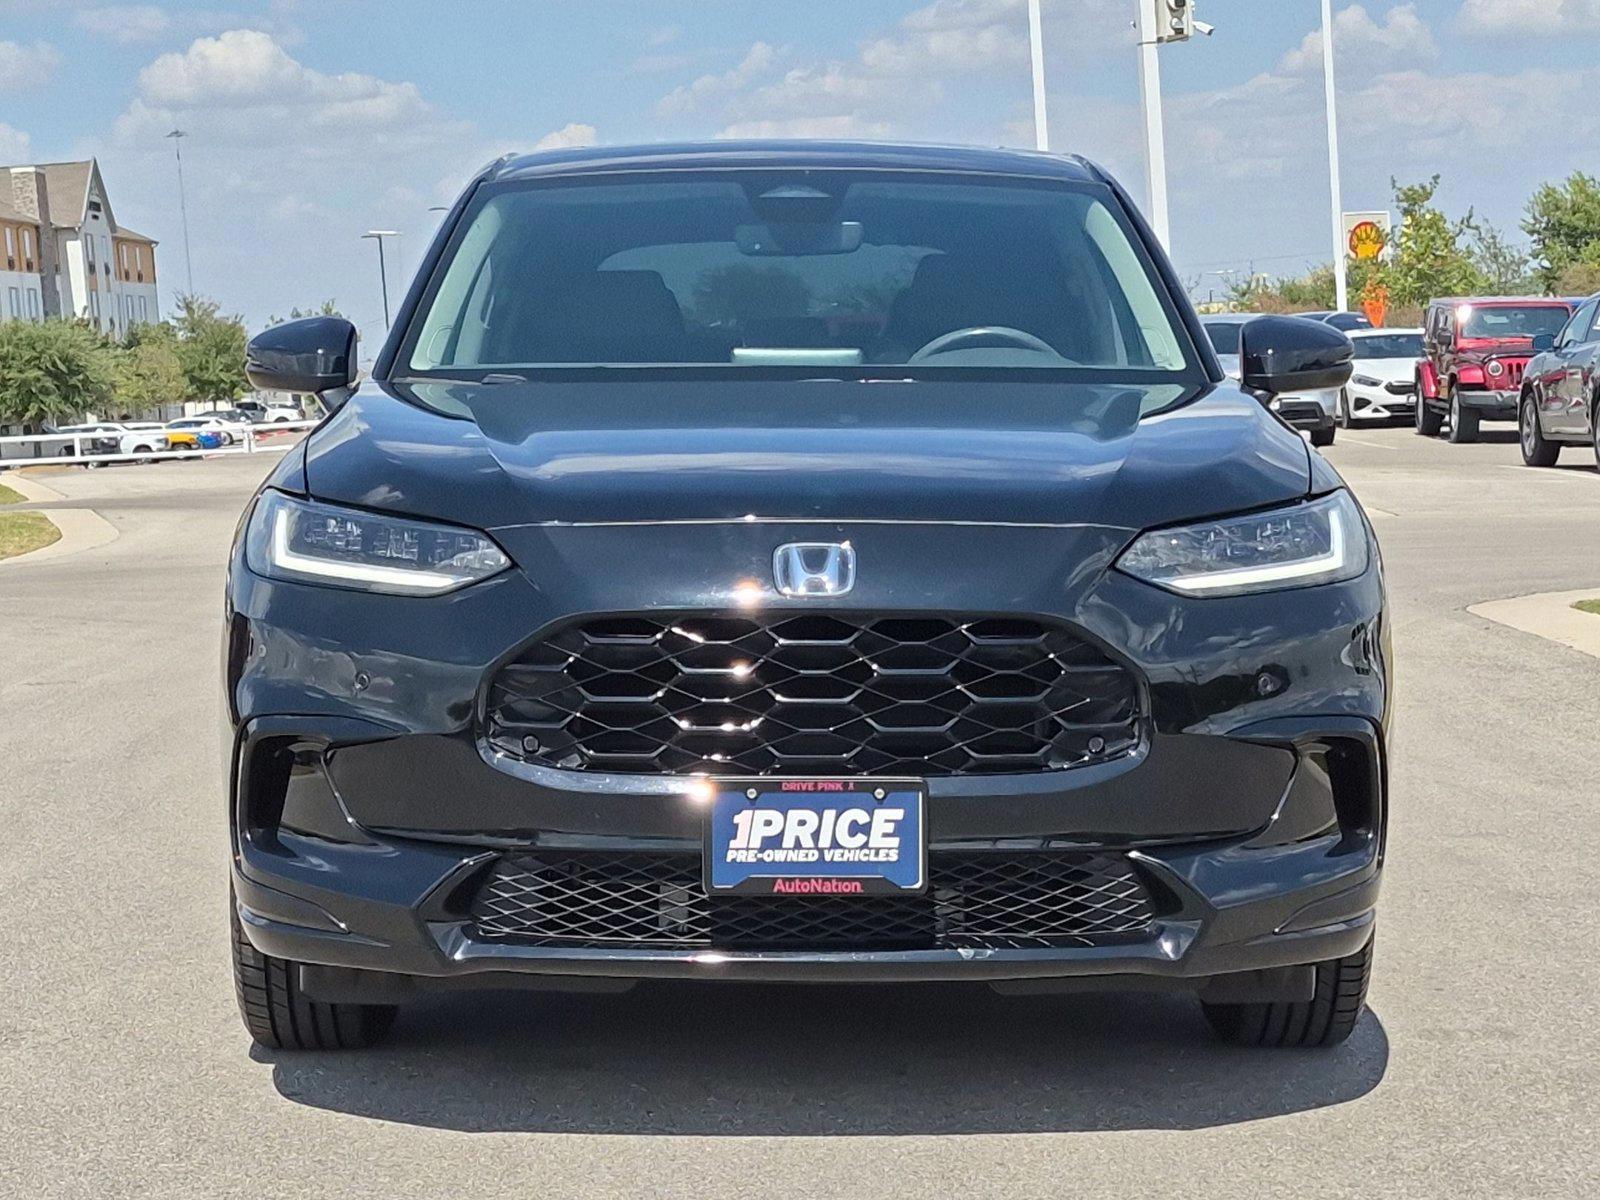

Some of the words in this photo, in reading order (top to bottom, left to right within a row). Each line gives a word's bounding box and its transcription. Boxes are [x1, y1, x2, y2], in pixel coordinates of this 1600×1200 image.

[781, 782, 815, 791] DRIVE
[817, 782, 844, 791] PINK
[726, 848, 819, 863] PRE-OWNED
[823, 848, 899, 862] VEHICLES
[773, 879, 862, 893] AutoNation
